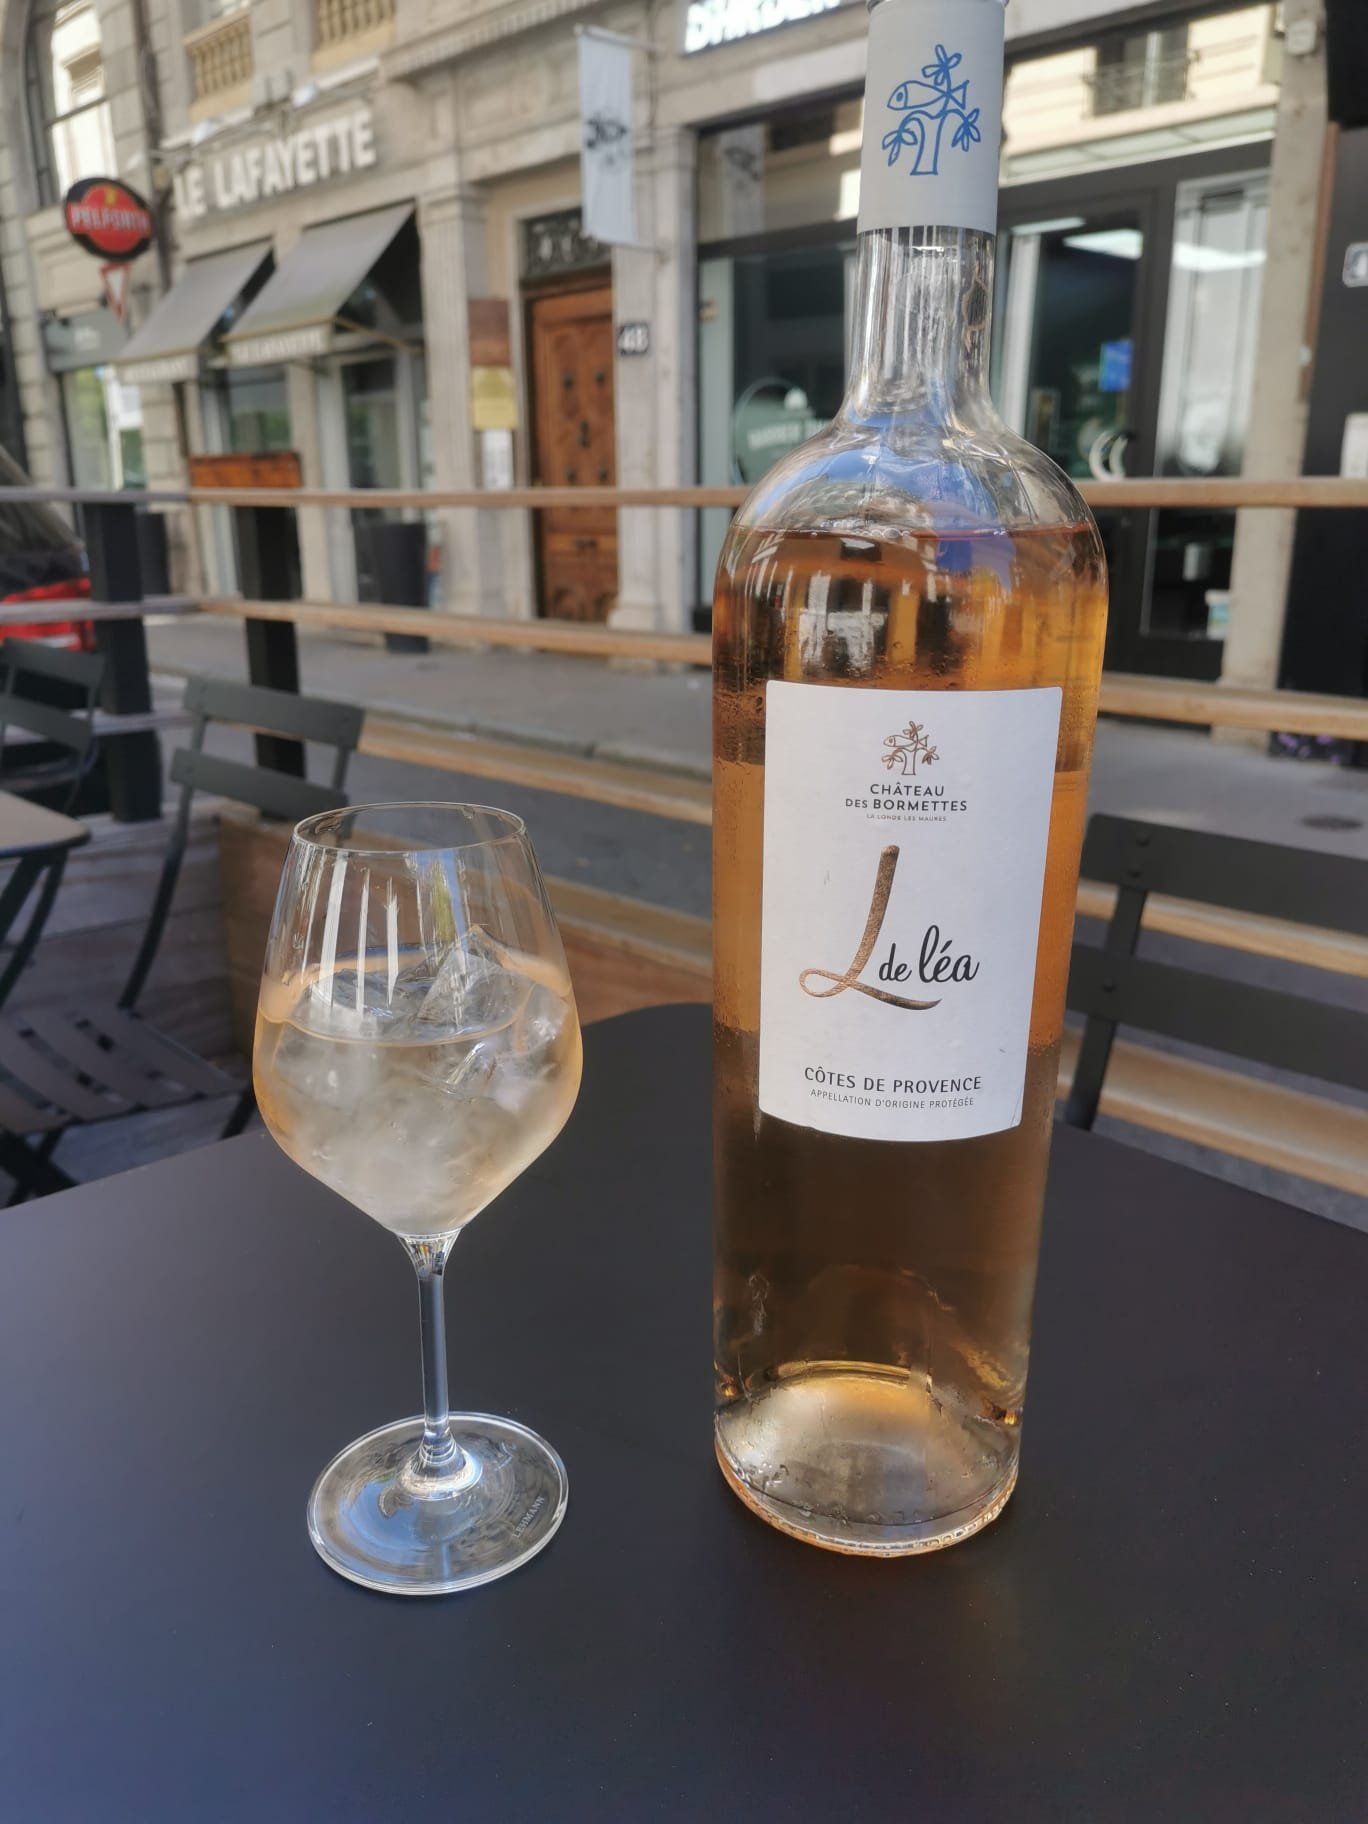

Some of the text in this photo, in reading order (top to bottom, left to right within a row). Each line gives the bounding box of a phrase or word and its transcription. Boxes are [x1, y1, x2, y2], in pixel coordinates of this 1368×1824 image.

[173, 109, 377, 218] LE LAFAYETTE
[870, 781, 945, 797] CHÂTEAU
[845, 798, 967, 812] DES BORMETTES
[799, 845, 980, 1010] L de léa
[804, 1066, 983, 1094] CÔTES DE PROVENCE
[810, 1088, 974, 1109] APPELLATION D'ORIGINE PROTÉGÉE
[513, 1496, 545, 1538] LEHMANN
